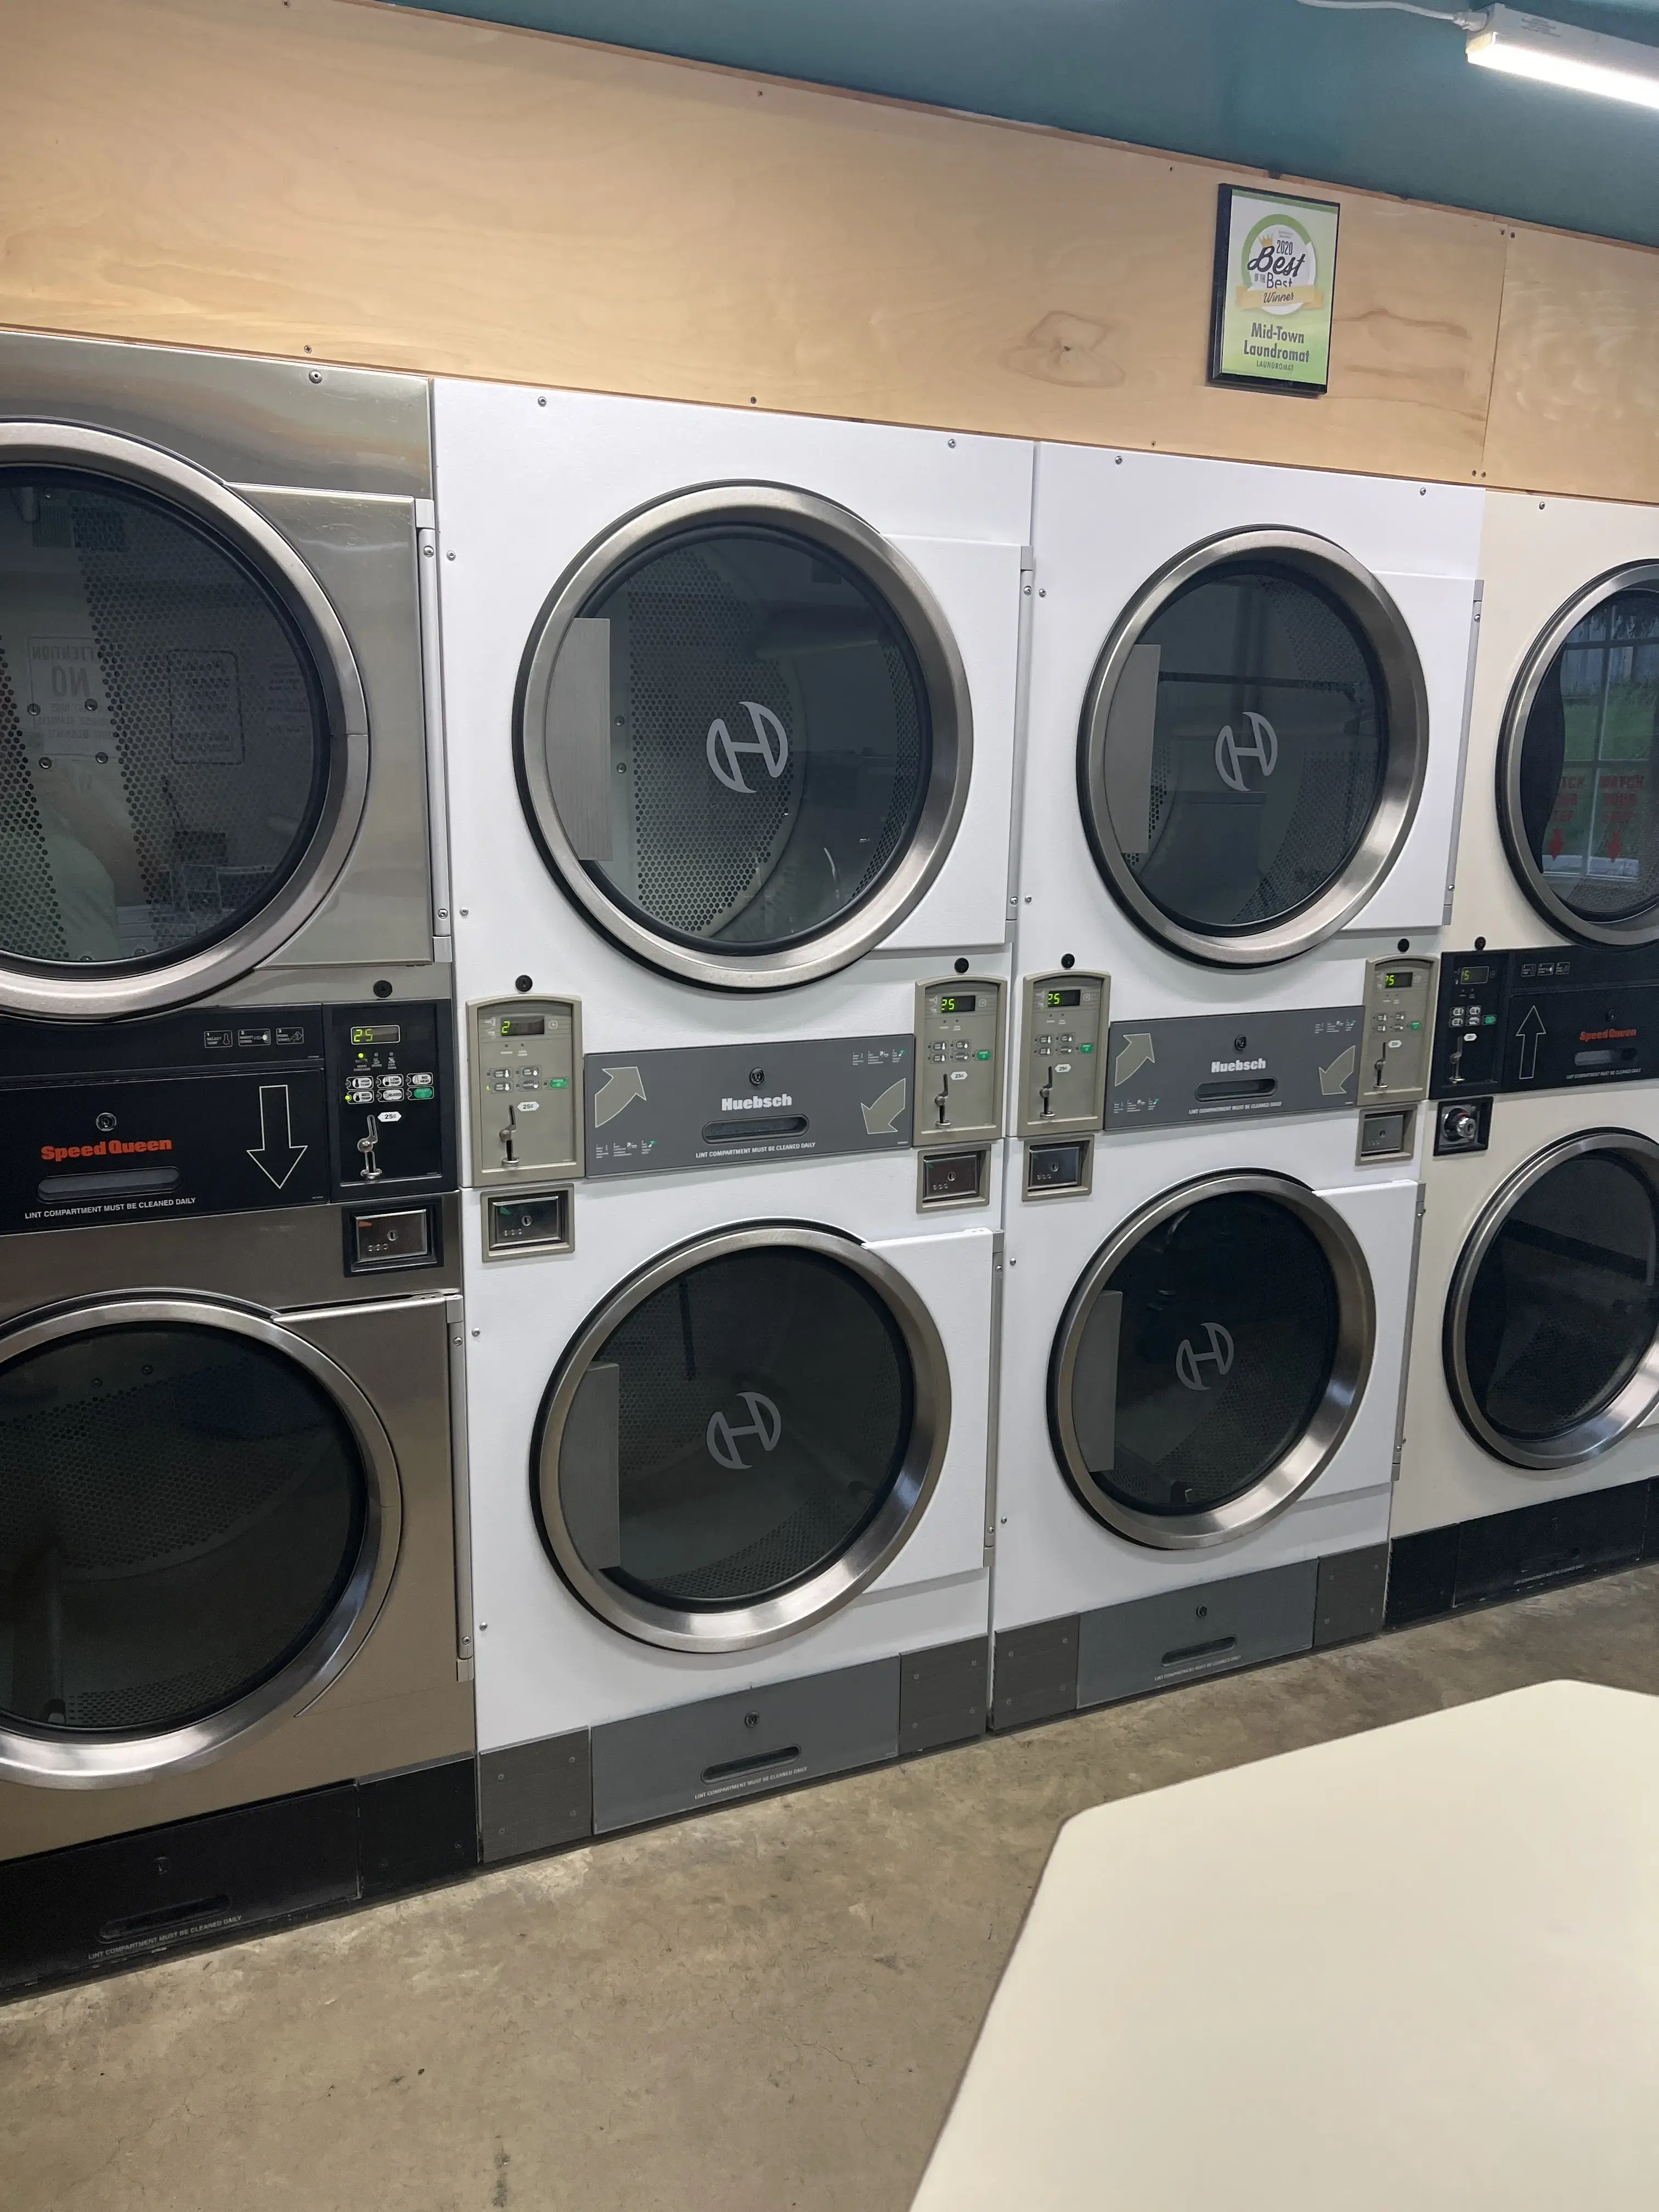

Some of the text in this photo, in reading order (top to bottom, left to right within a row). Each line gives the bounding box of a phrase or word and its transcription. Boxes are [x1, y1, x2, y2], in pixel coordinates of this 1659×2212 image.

[1276, 240, 1293, 256] 2020
[1247, 245, 1306, 277] Best
[1266, 272, 1293, 289] Best
[1263, 292, 1294, 303] Winner
[1251, 322, 1305, 344] Mid-Town
[1244, 340, 1310, 363] Laundromat
[1256, 360, 1294, 371] LAUNDROMAT
[941, 998, 955, 1011] 25
[501, 1021, 510, 1033] 2
[1579, 1028, 1637, 1042] Speed Queen
[353, 1029, 373, 1042] 25
[1211, 1058, 1266, 1074] Huebsch
[721, 1093, 792, 1111] Huebsch
[41, 1139, 172, 1162] Speed Queen
[709, 1148, 751, 1157] COMPARTMENT
[25, 1211, 42, 1219] LINT
[44, 1206, 102, 1217] COMPARTMENT
[104, 1204, 125, 1212] MUST
[138, 1199, 174, 1209] CLEANED
[175, 1197, 196, 1205] DAILY
[695, 1791, 706, 1800] LINT
[707, 1782, 747, 1796] COMPARTMENT
[747, 1778, 761, 1786] MUST
[770, 1770, 793, 1780] CLEANED
[793, 1766, 808, 1774] DAILY
[88, 1951, 104, 1960] LINT
[105, 1937, 158, 1956] COMPARTMENT
[159, 1932, 178, 1942] MUST
[190, 1920, 222, 1934] CLEANED
[223, 1915, 241, 1925] DAILY
